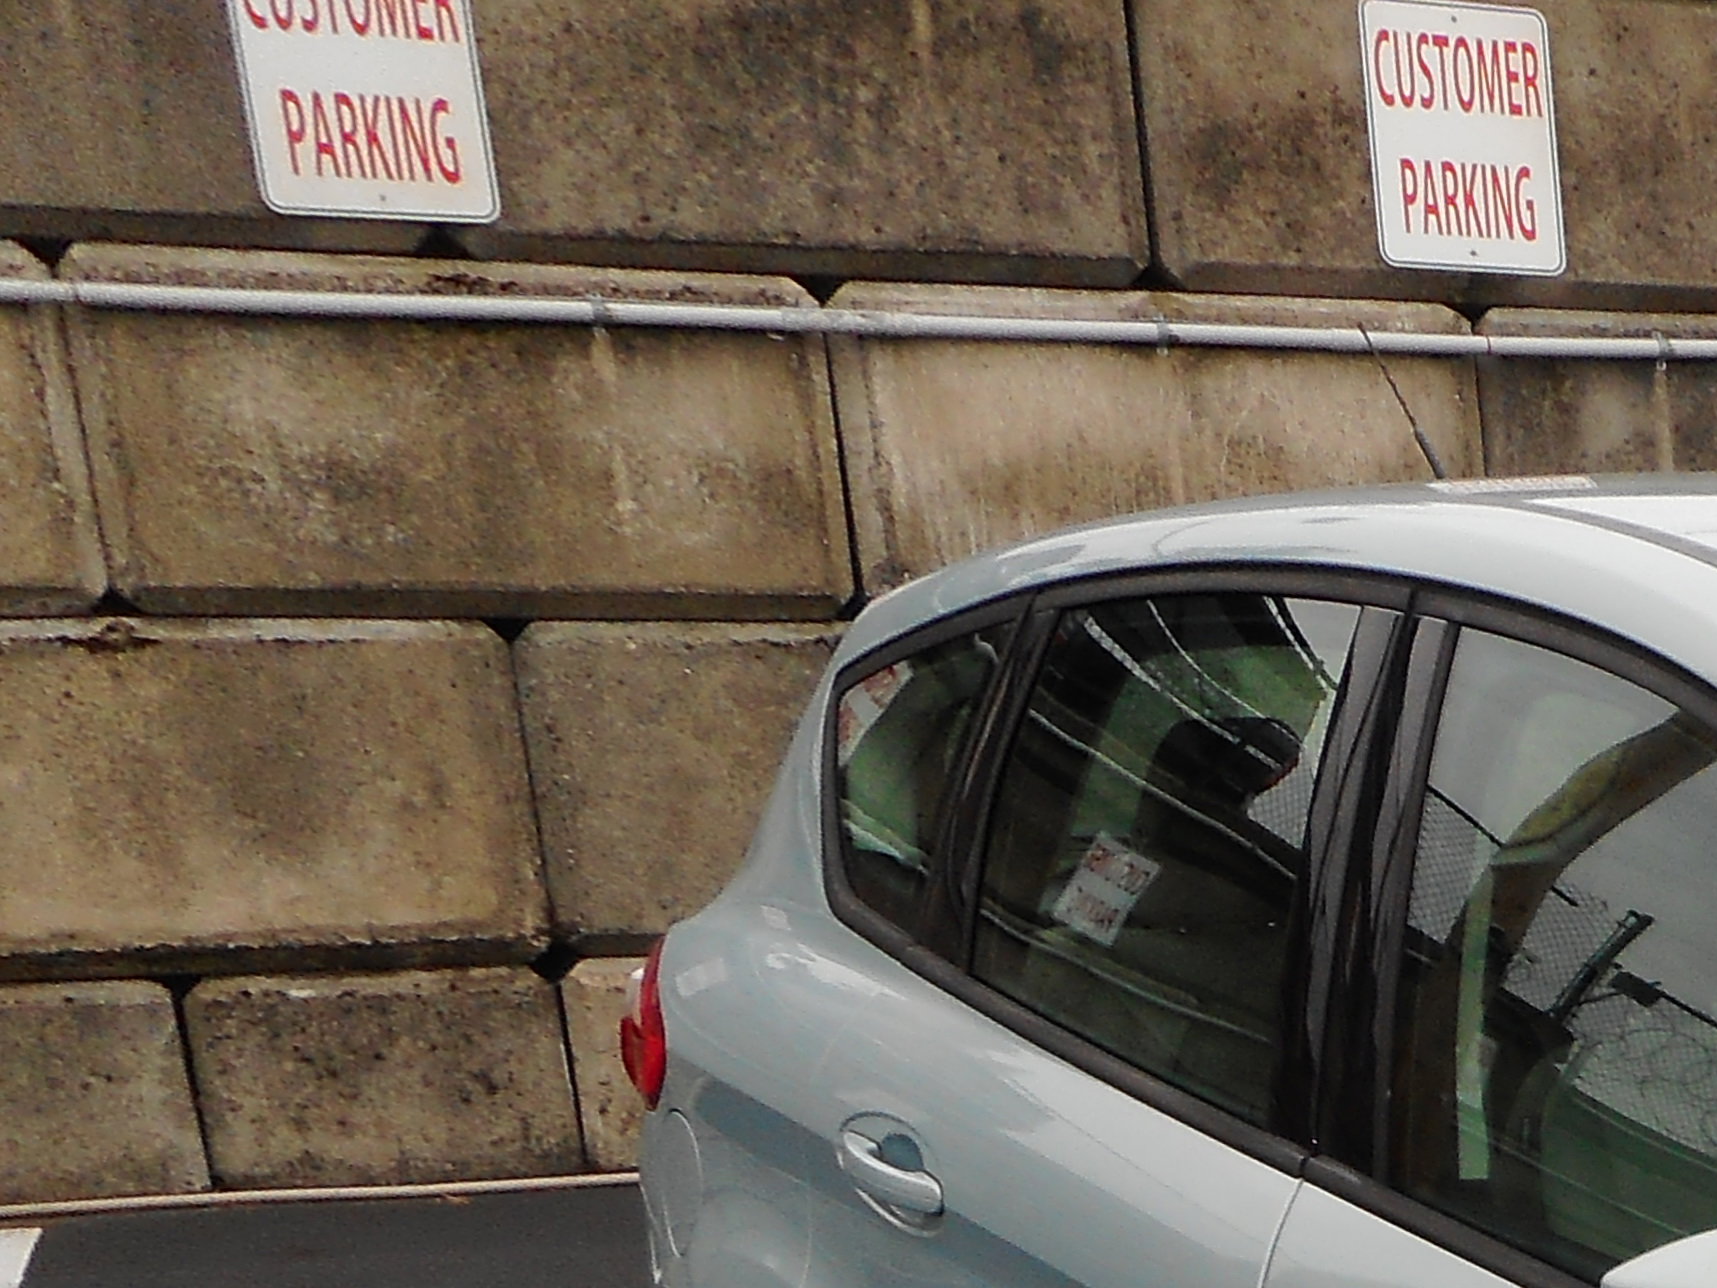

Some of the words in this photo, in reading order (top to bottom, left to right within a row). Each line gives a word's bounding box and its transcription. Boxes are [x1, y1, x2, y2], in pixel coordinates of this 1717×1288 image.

[1373, 28, 1544, 118] CUSTOMER
[279, 88, 462, 184] PARKING
[1399, 157, 1537, 242] PARKING
